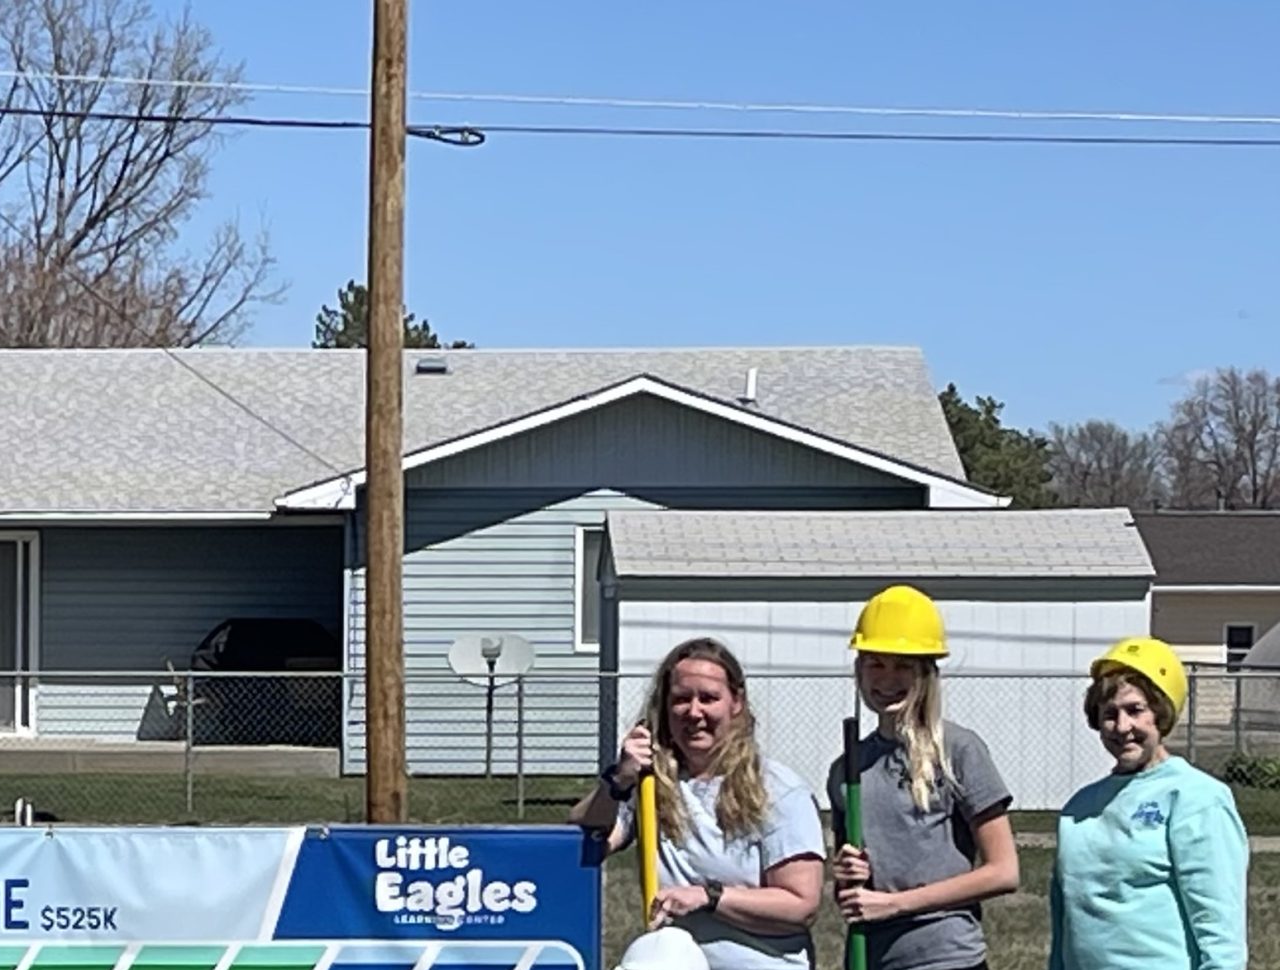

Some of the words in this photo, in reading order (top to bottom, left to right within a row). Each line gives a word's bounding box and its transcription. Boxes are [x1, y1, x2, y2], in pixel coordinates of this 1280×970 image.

[375, 836, 470, 870] Little
[375, 870, 538, 931] Eagles
[40, 905, 118, 933] $525K
[393, 914, 454, 924] LEARN
